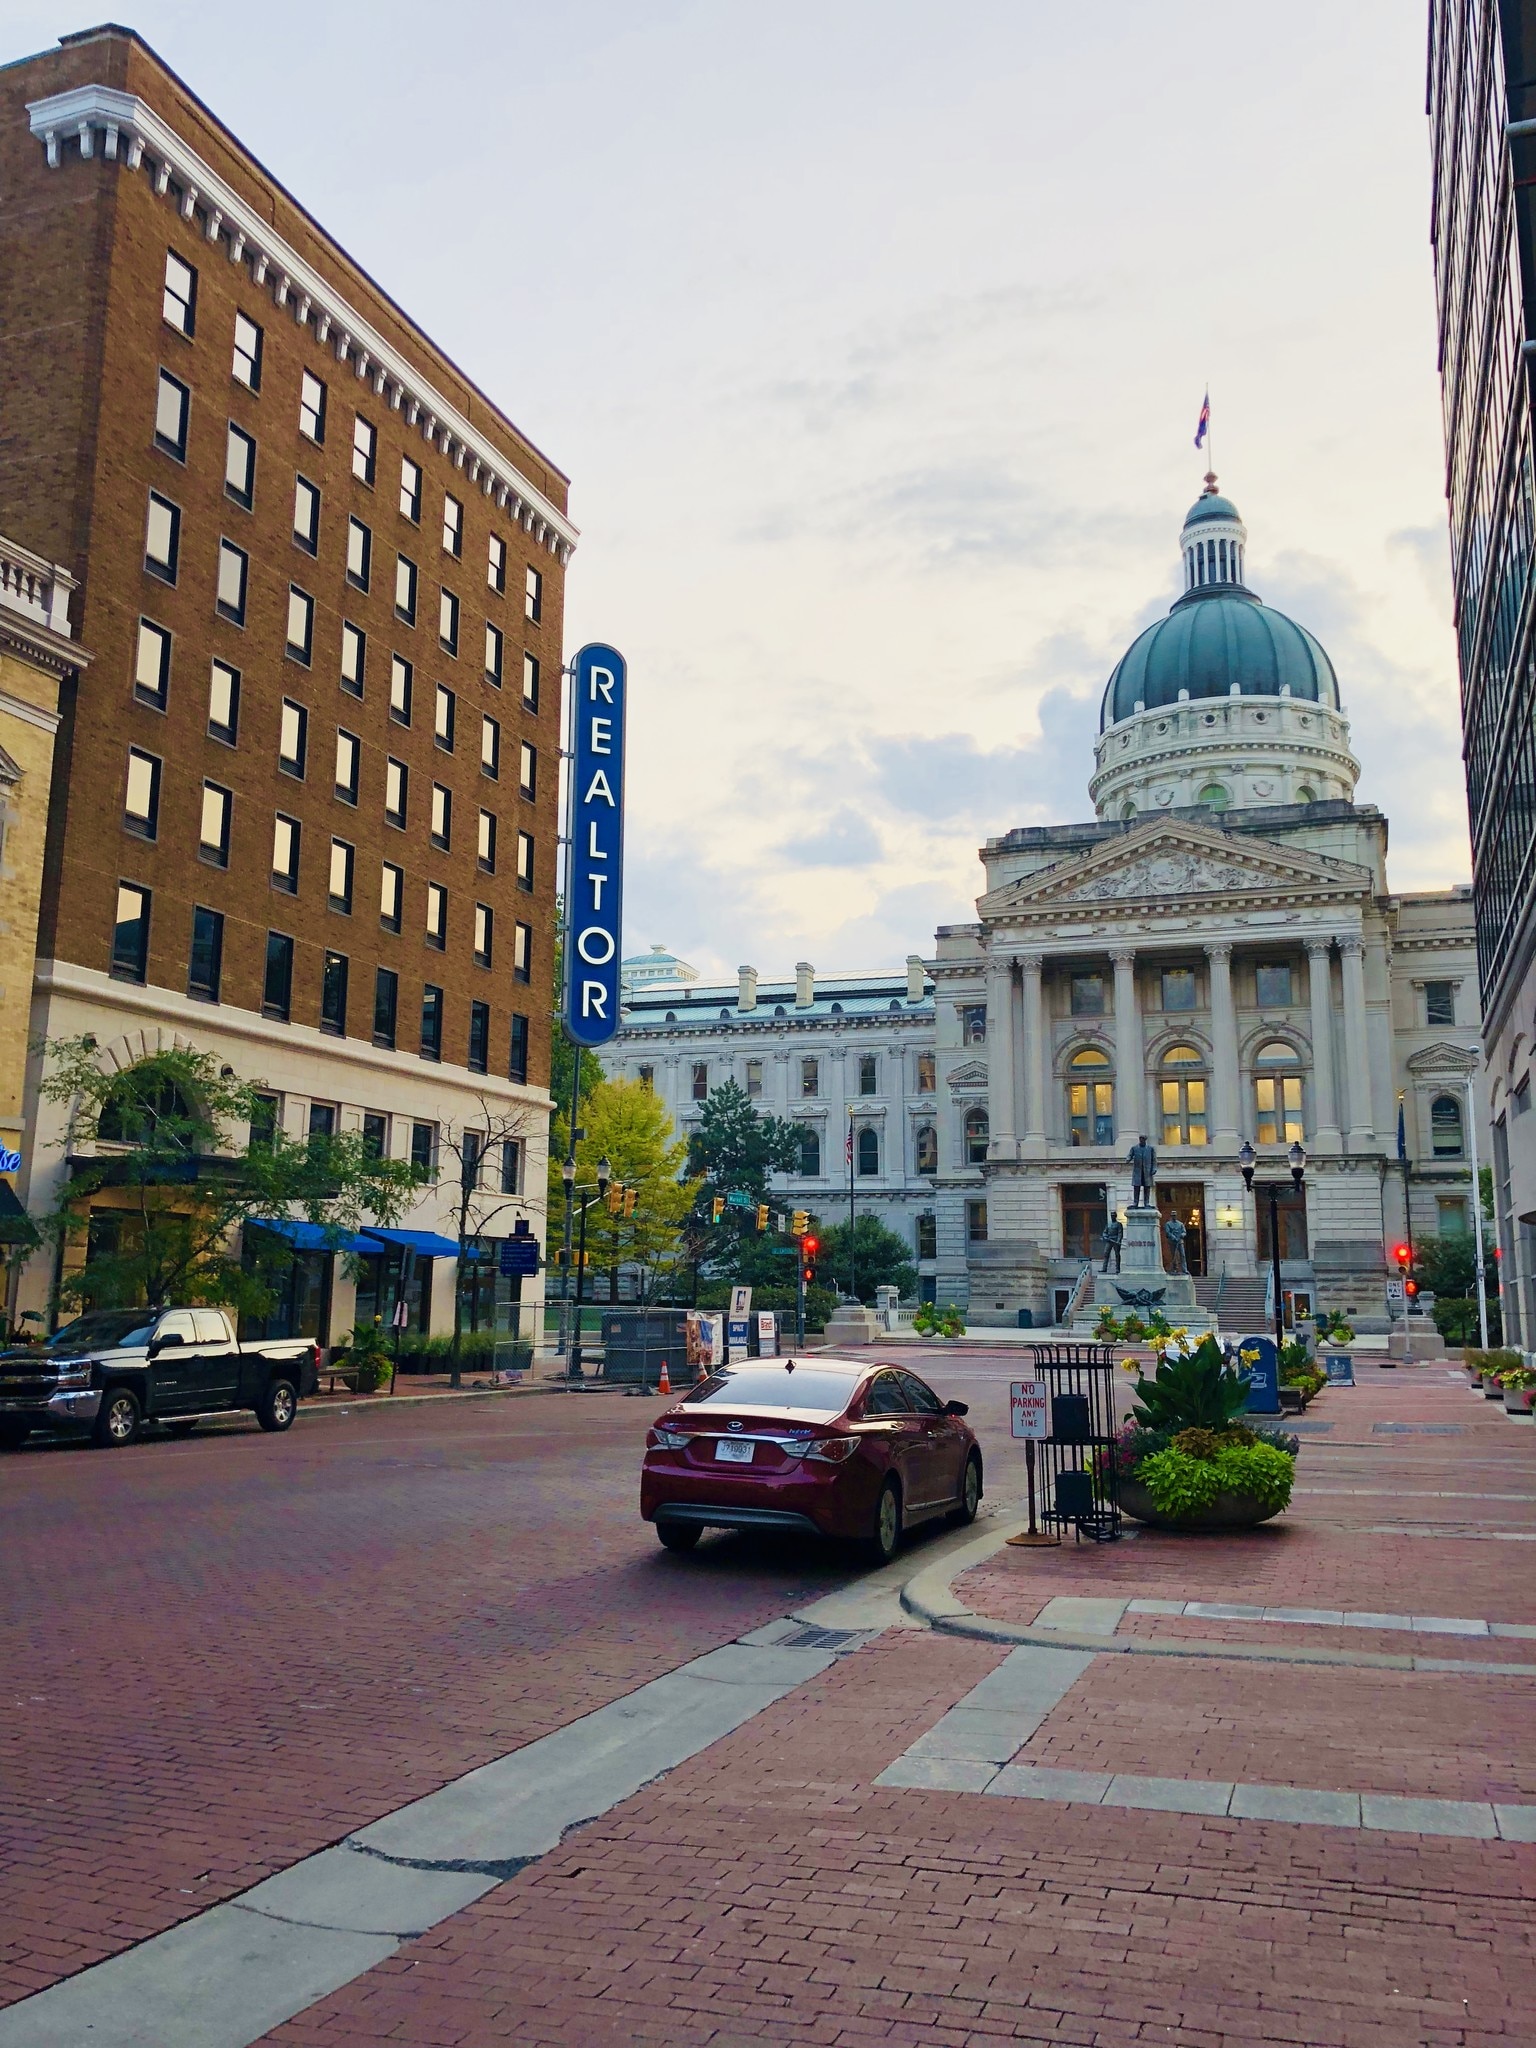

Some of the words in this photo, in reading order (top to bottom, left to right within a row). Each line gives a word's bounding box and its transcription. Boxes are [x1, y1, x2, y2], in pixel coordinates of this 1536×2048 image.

[577, 664, 616, 1019] REALTOR
[1021, 1384, 1035, 1395] NO
[1012, 1397, 1045, 1408] PARKING
[1022, 1410, 1036, 1418] ANY
[1021, 1419, 1038, 1427] TIME
